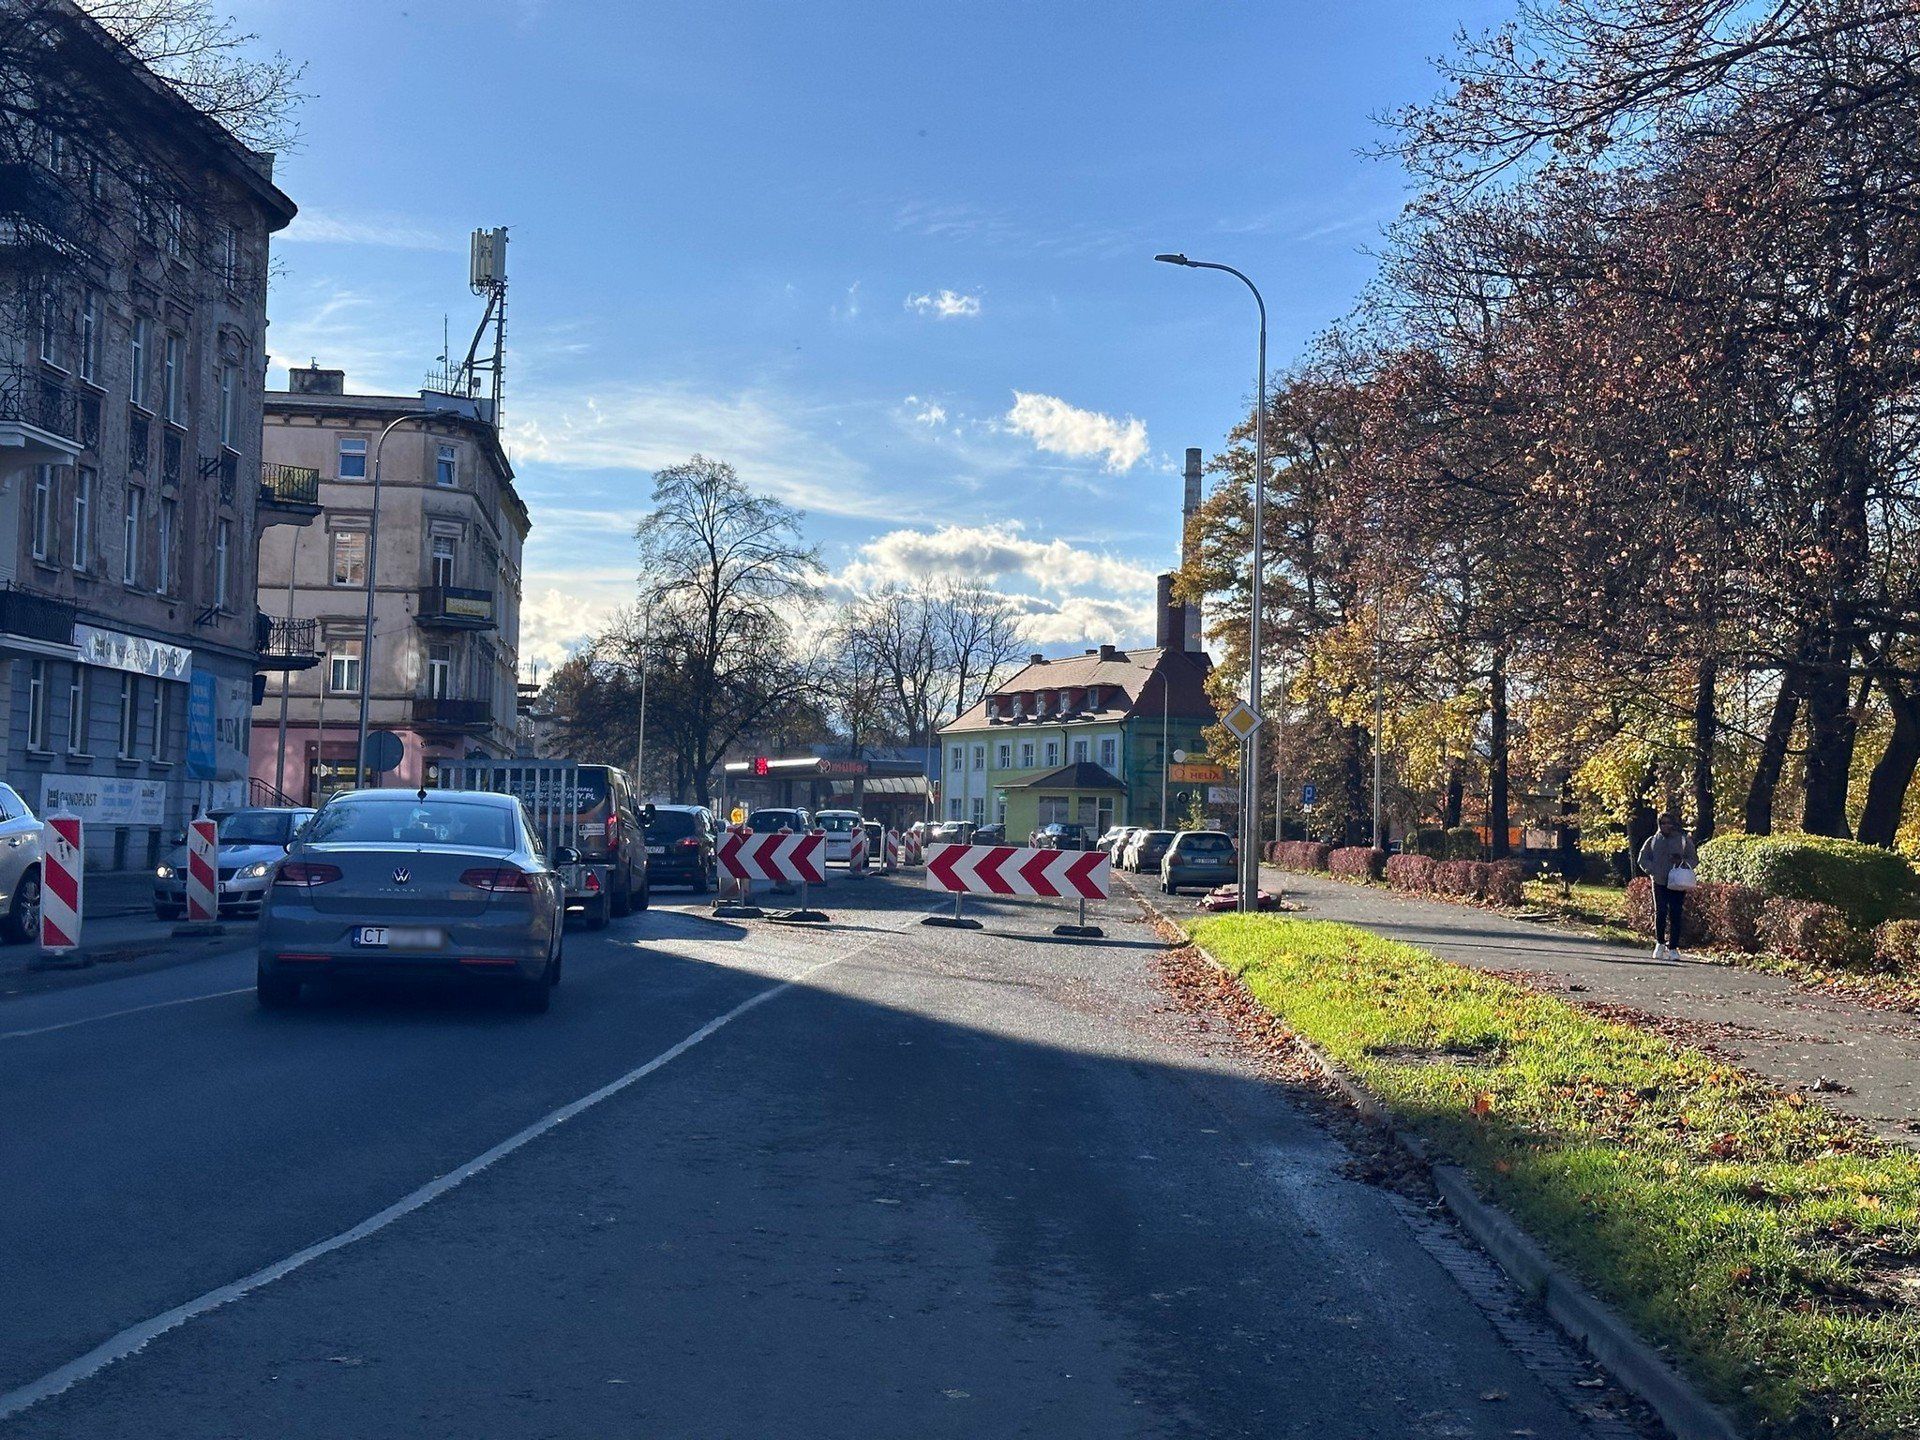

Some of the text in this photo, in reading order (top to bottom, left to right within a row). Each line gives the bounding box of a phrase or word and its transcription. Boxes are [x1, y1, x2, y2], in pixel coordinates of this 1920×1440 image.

[1190, 771, 1220, 780] HELIX
[1305, 786, 1313, 801] P
[363, 928, 384, 943] CT
